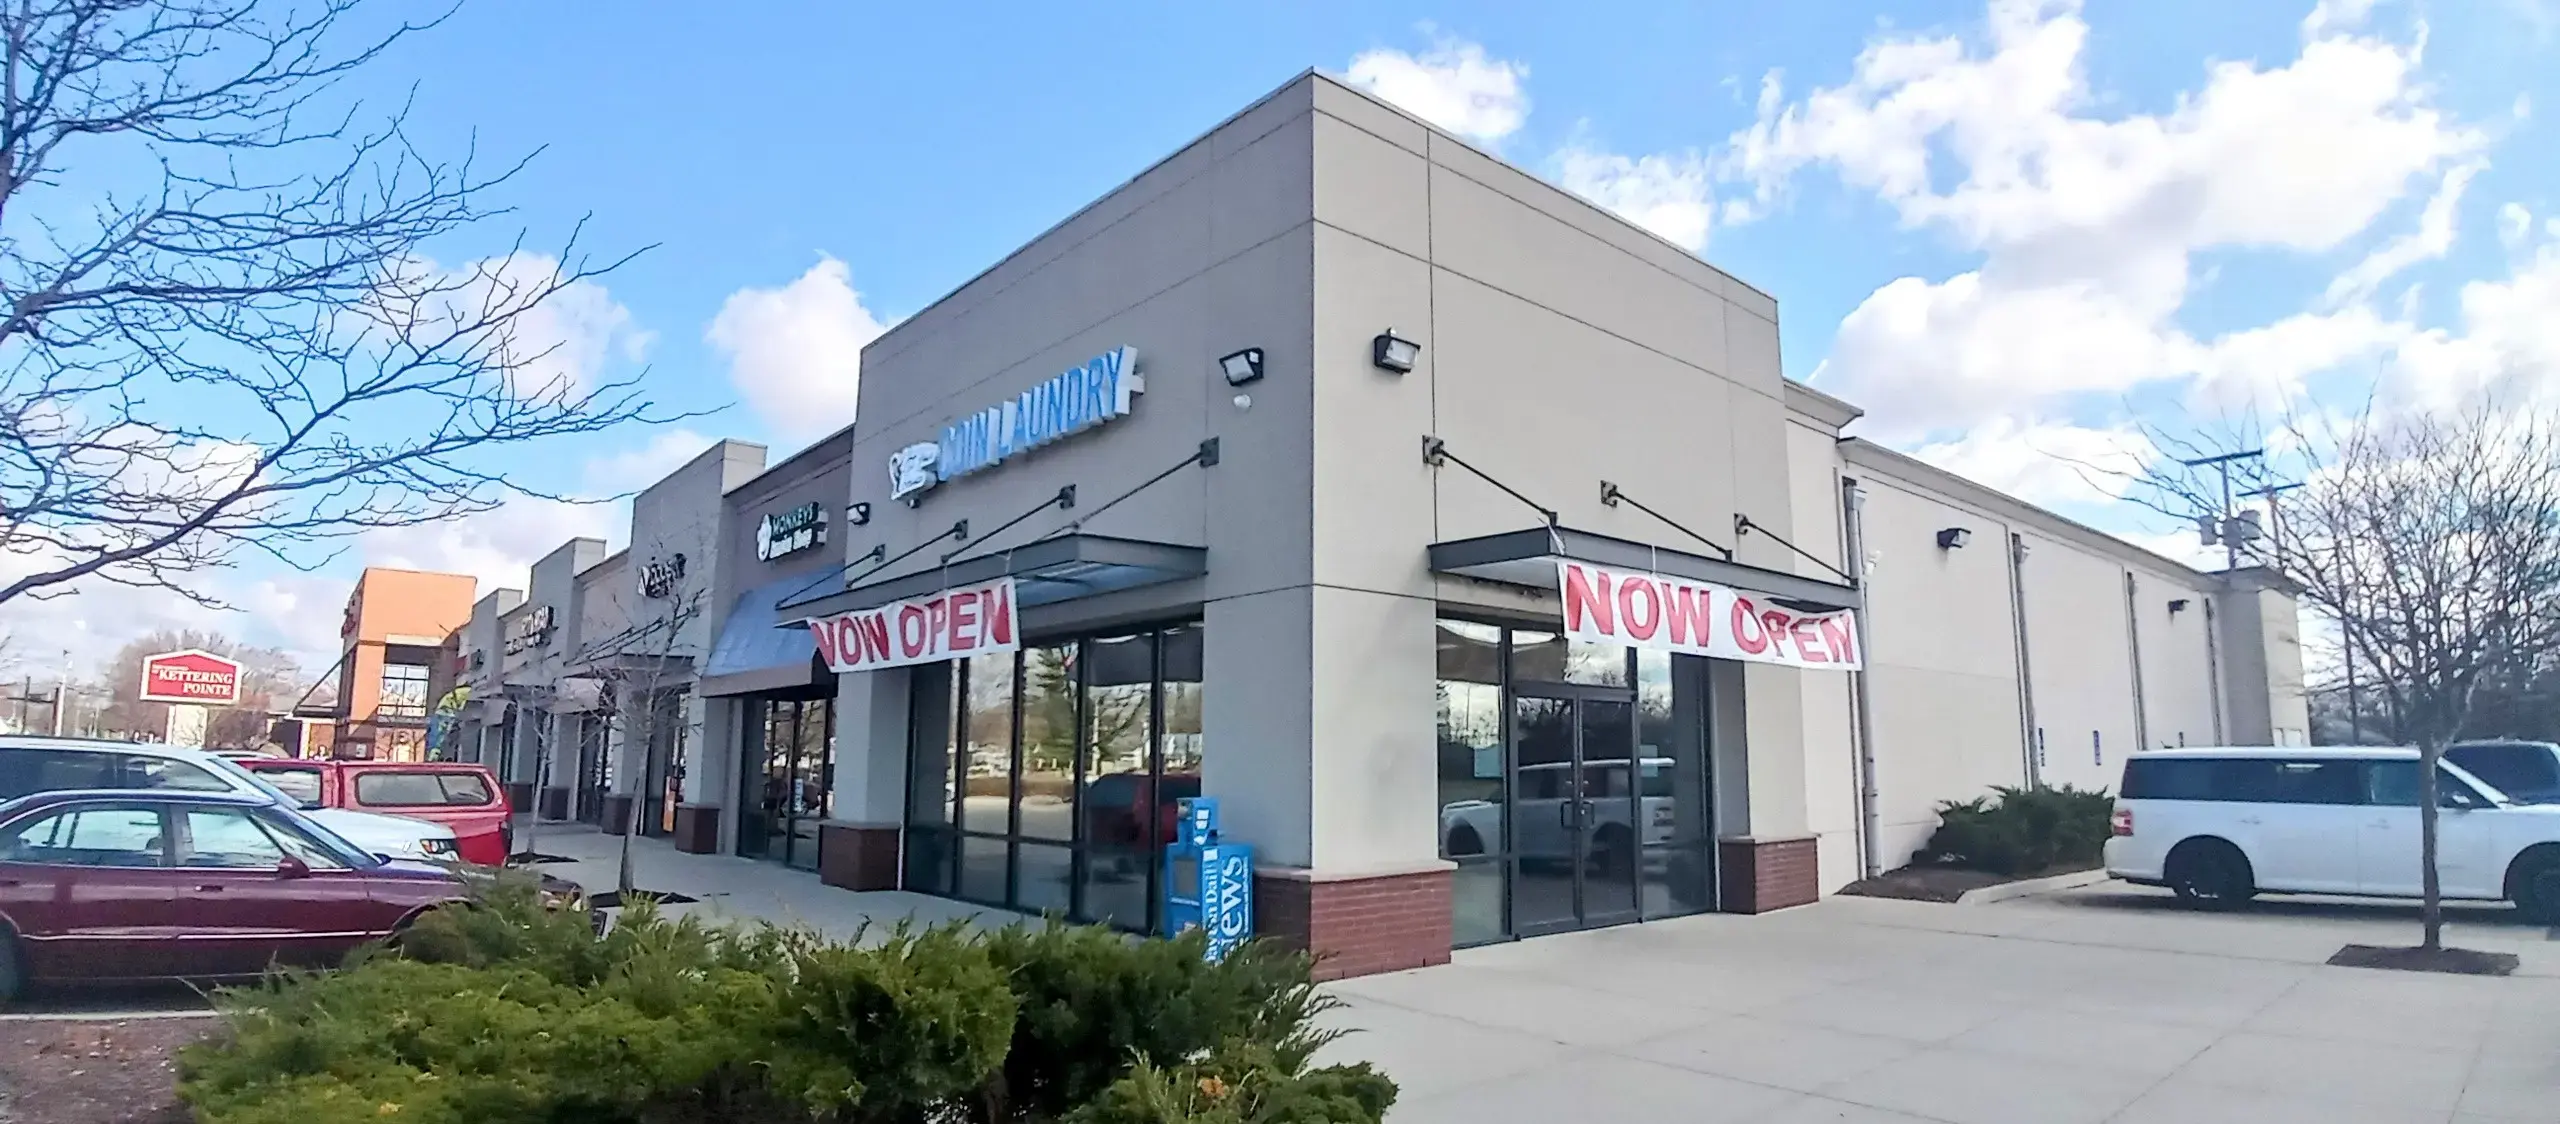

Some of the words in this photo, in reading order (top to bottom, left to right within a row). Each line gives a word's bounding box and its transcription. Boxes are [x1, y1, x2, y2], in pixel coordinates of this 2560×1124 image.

[936, 411, 1000, 481] COIN
[1000, 345, 1138, 456] LAUNDRY
[900, 587, 1011, 659] OPEN
[1565, 567, 1711, 647] NOW
[1731, 598, 1856, 664] OPEN
[159, 669, 234, 684] KETTERING
[183, 683, 232, 695] POINTE
